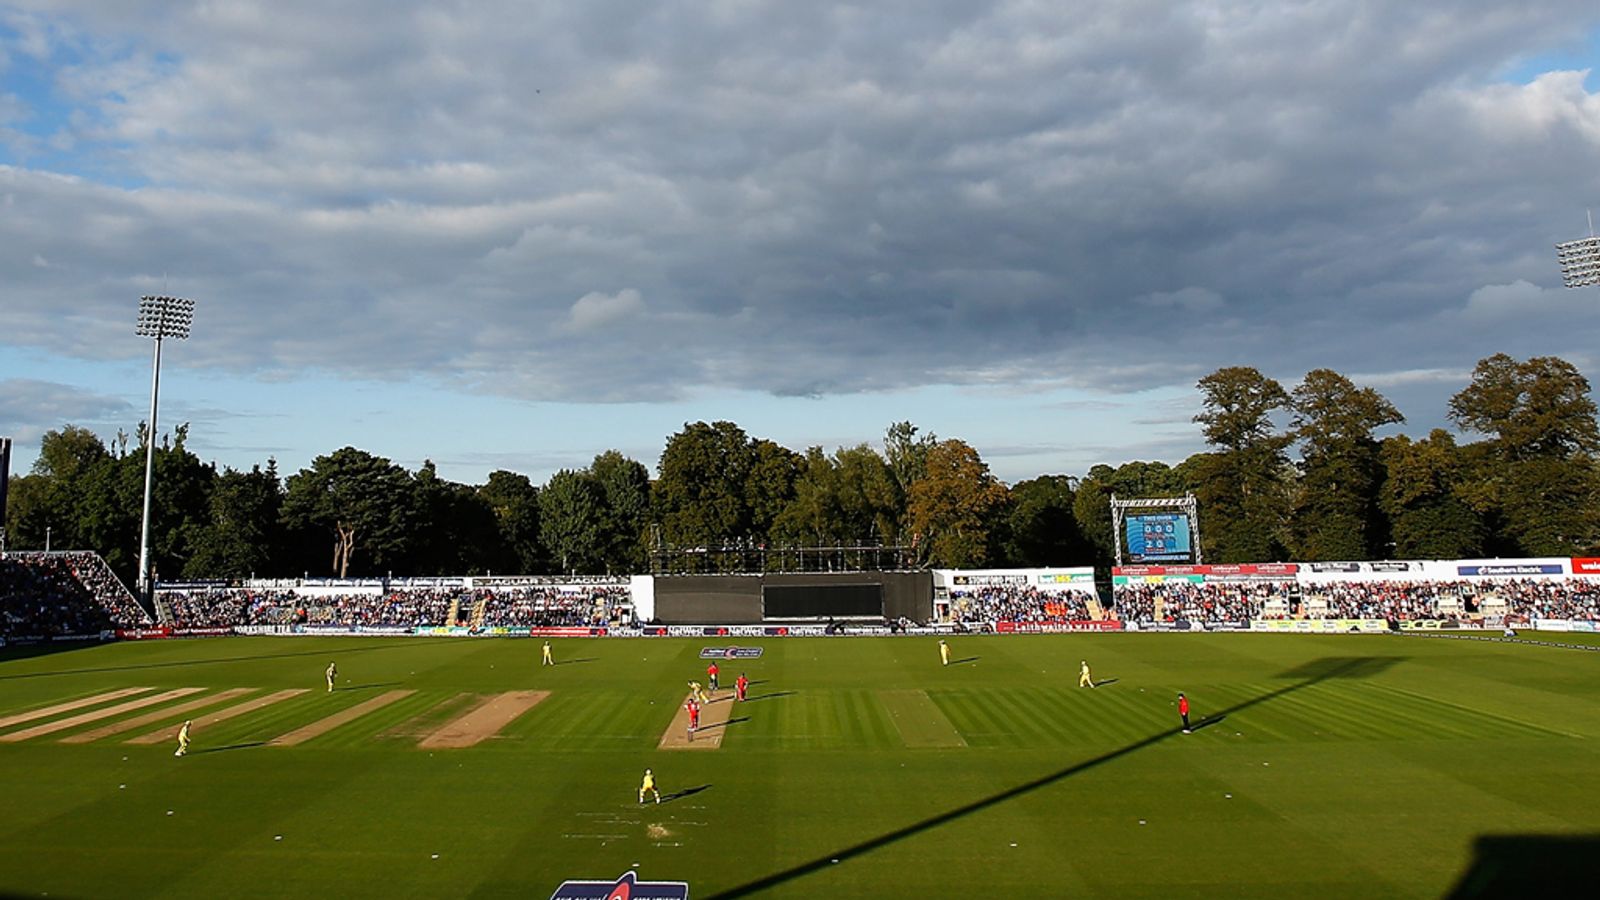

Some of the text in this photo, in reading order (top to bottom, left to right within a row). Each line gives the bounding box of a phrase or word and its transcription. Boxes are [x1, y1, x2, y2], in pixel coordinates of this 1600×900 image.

[1155, 525, 1162, 533] 0
[1166, 525, 1173, 533] 0
[1146, 540, 1164, 548] 2 0
[566, 577, 617, 585] JAGUAR
[969, 575, 1026, 585] STOWFORD PRESS
[234, 625, 275, 634] YORKSHIRE
[276, 625, 291, 634] TEA
[1398, 619, 1450, 631] acer
[668, 627, 703, 636] NatWest
[729, 626, 764, 636] NatWest
[789, 626, 825, 636] NatWest
